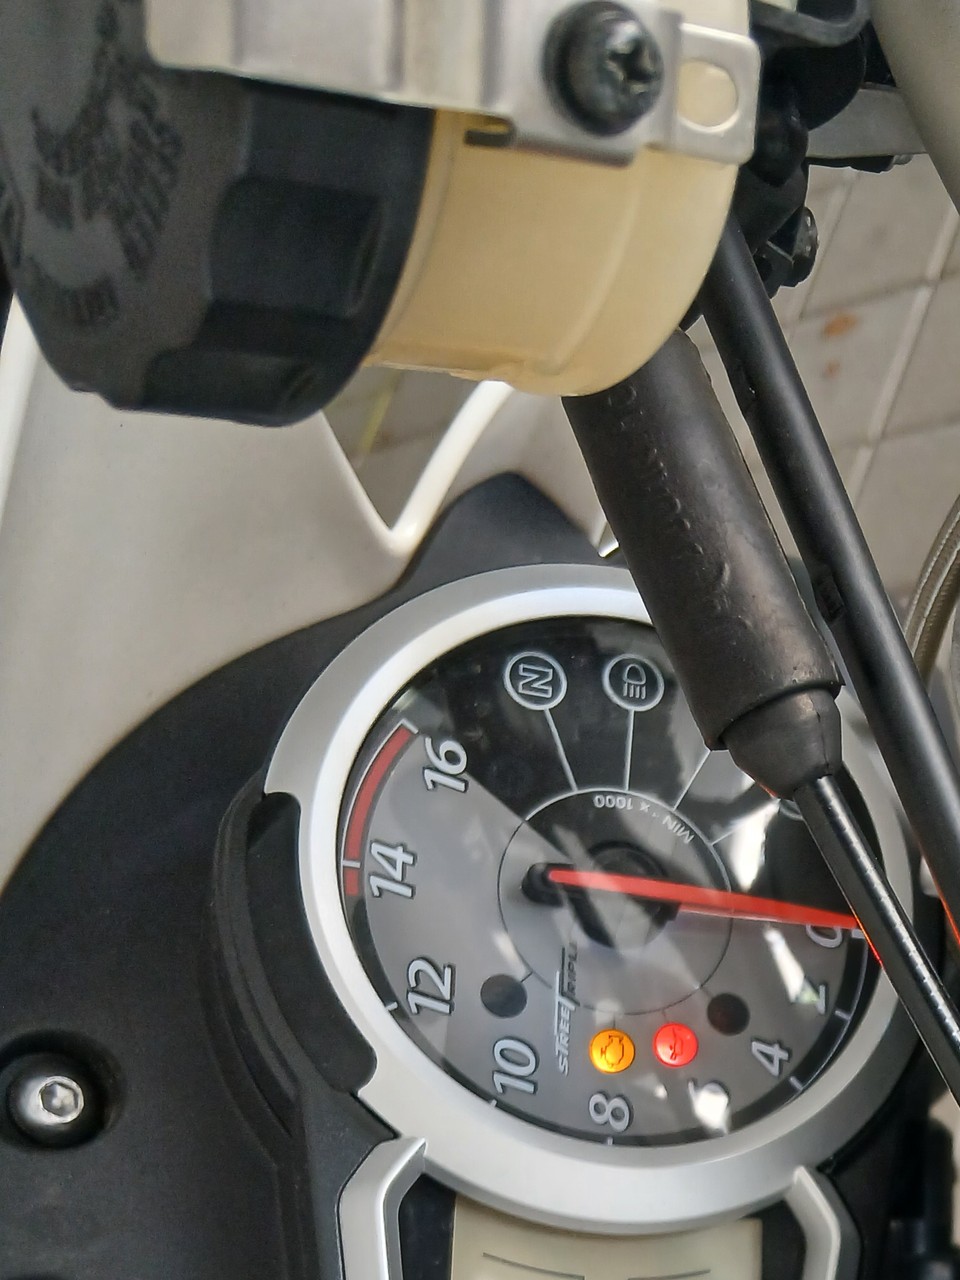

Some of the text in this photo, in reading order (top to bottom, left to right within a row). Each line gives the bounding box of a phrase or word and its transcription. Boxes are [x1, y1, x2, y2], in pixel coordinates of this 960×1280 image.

[518, 664, 554, 698] N
[422, 735, 468, 793] 16
[593, 795, 634, 810] 1000
[369, 839, 418, 899] 14
[405, 956, 456, 1017] 12
[554, 971, 577, 1077] STREET
[492, 1037, 539, 1096] 10
[750, 1036, 792, 1076] 4
[588, 1092, 633, 1133] 8
